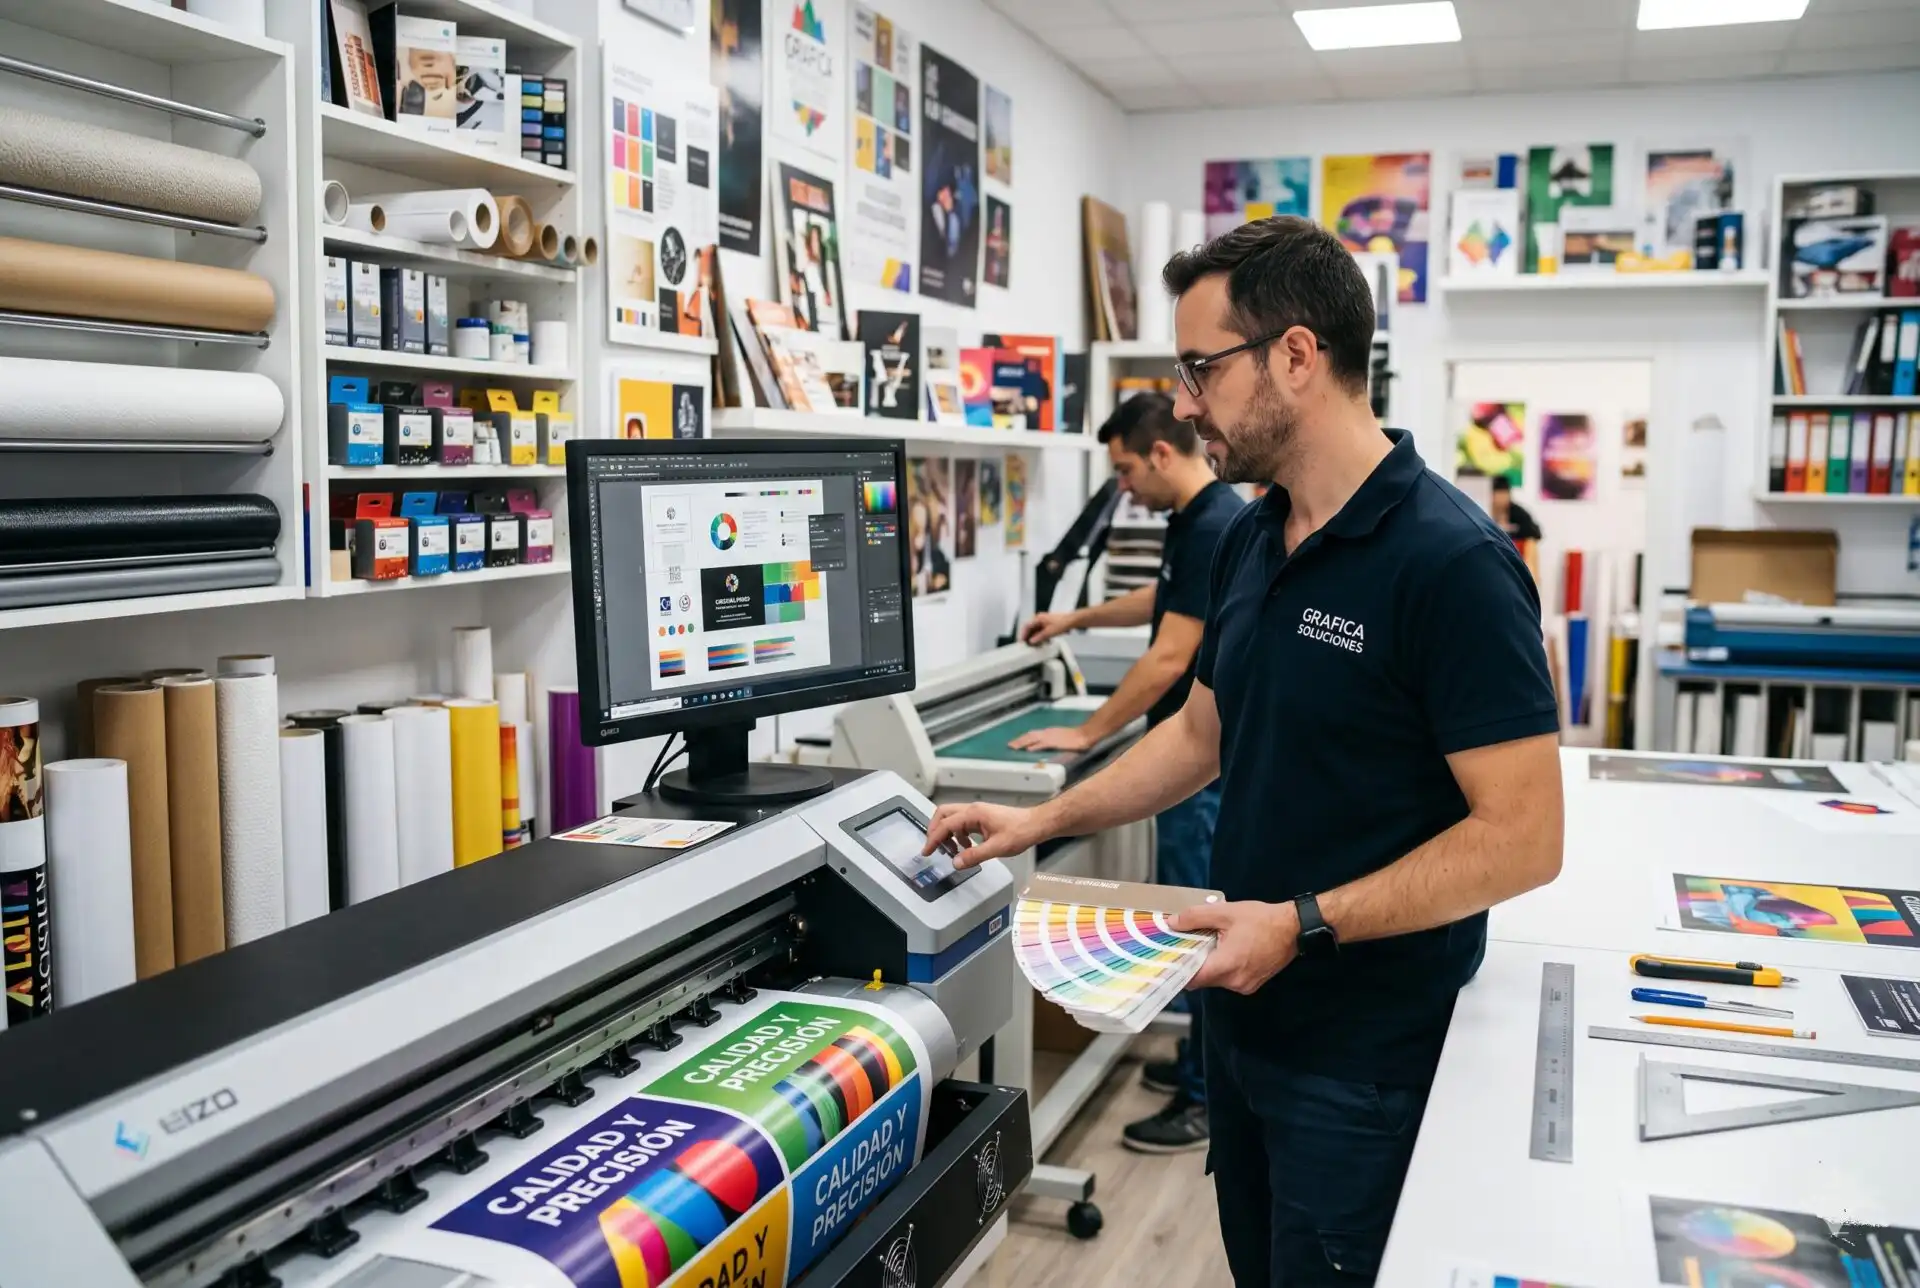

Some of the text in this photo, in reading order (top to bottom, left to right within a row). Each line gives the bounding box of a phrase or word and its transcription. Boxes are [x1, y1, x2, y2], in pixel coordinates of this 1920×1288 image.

[1297, 623, 1364, 653] SOLUCIONES
[1302, 607, 1364, 640] GRAFICA
[683, 1013, 800, 1084] CALIDAD Y
[718, 1016, 842, 1092] PRECISIÓN
[486, 1113, 648, 1215] CALIDAD Y
[526, 1119, 696, 1227] PRECISIÓN
[815, 1102, 907, 1206] CALIDAD Y
[811, 1138, 905, 1247] PRECISIÓN
[754, 1224, 769, 1260] Y
